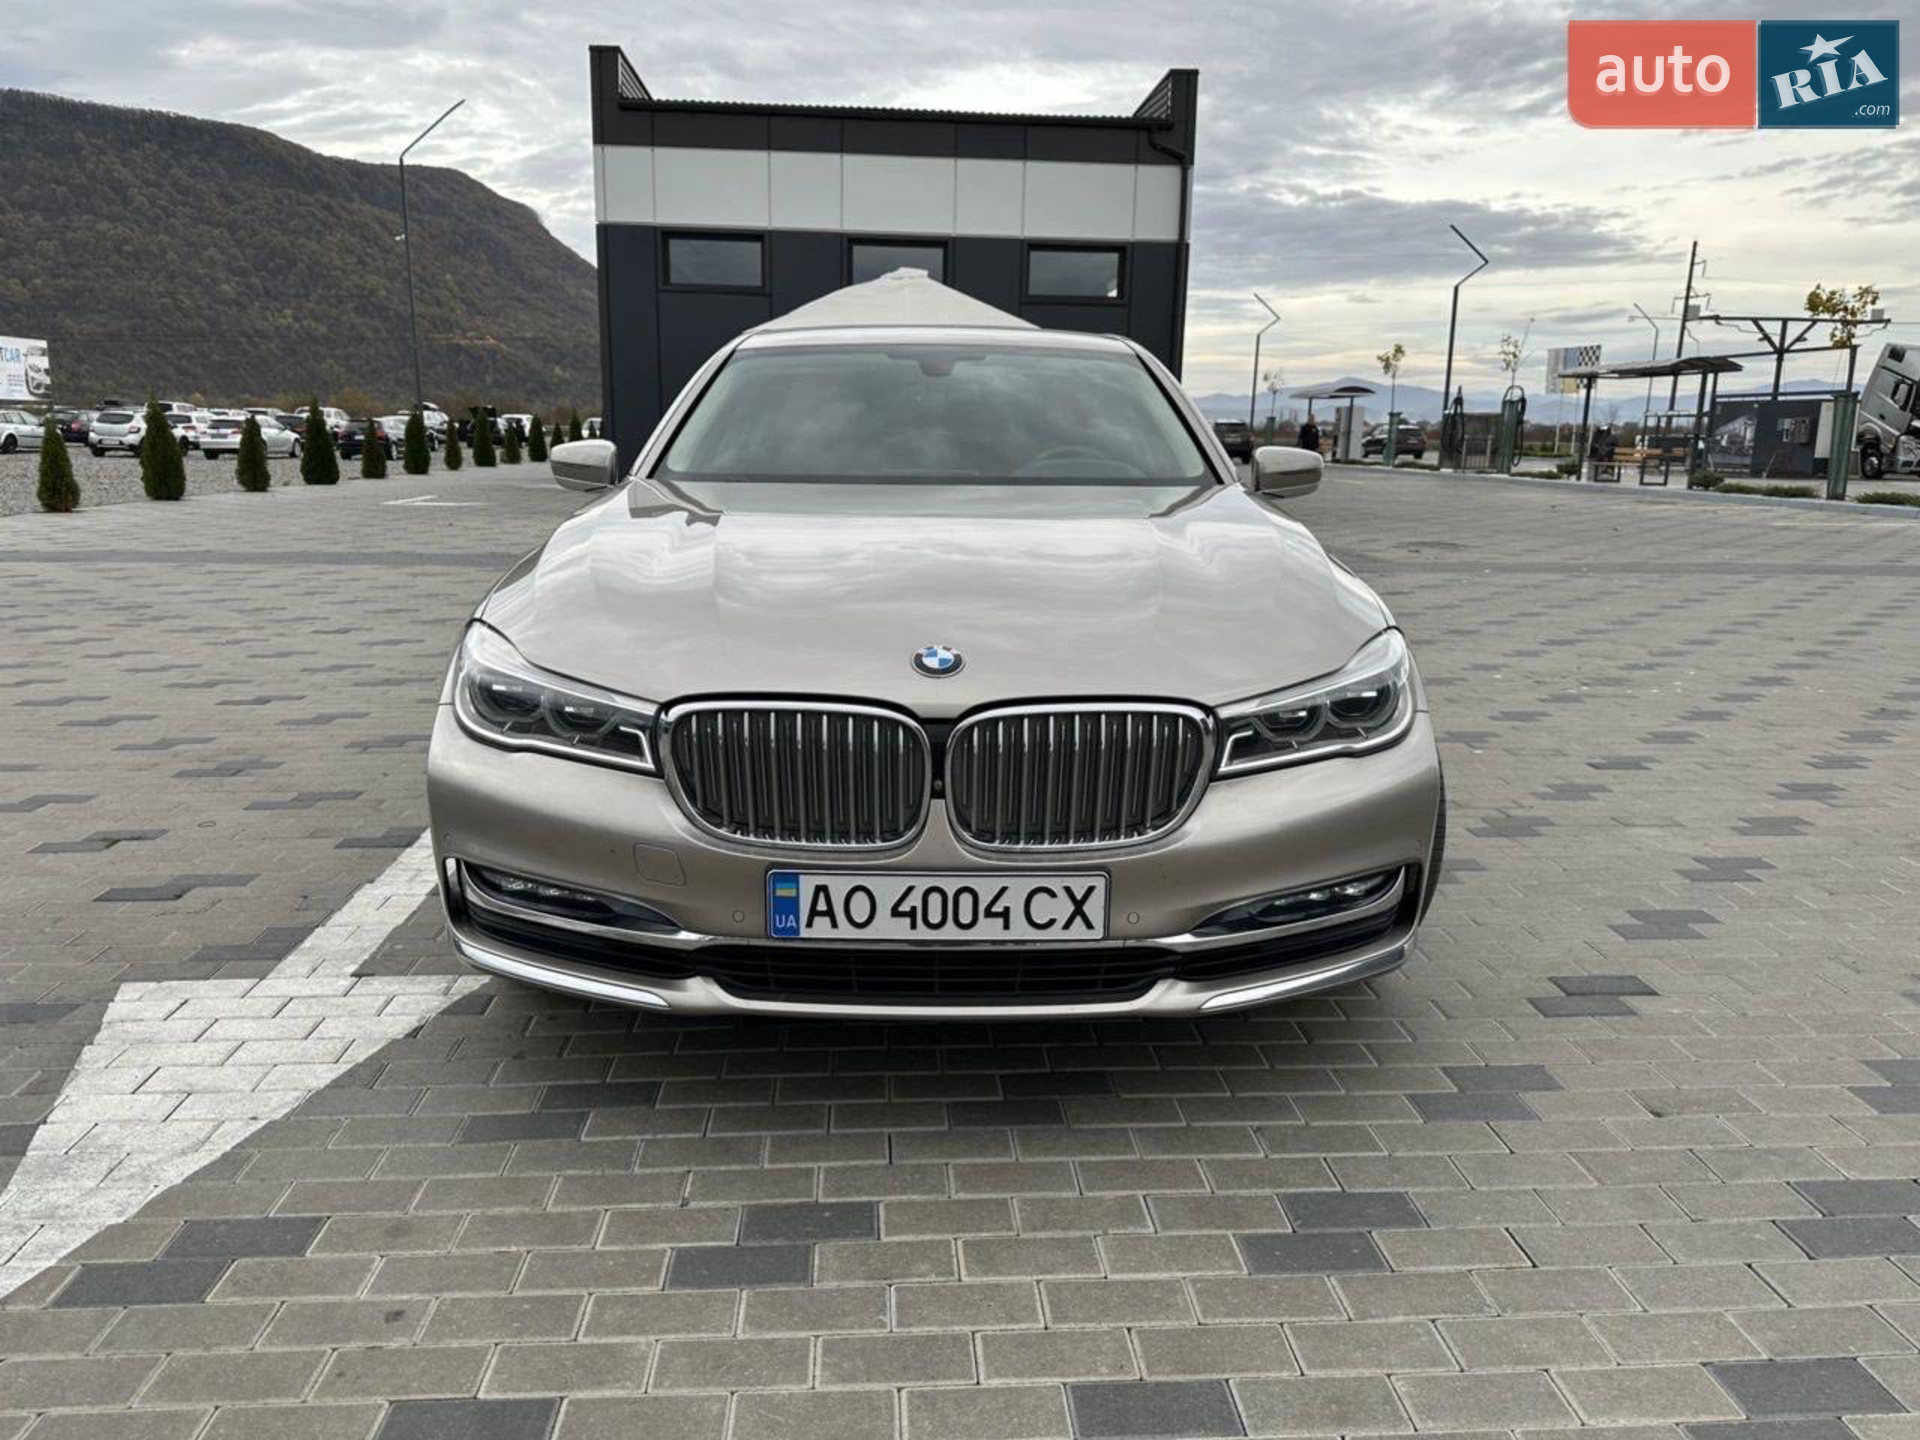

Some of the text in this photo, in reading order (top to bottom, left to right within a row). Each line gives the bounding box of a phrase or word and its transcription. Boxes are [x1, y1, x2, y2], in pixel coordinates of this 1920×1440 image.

[775, 914, 797, 929] UA
[805, 884, 1096, 931] AO 4004 CX
